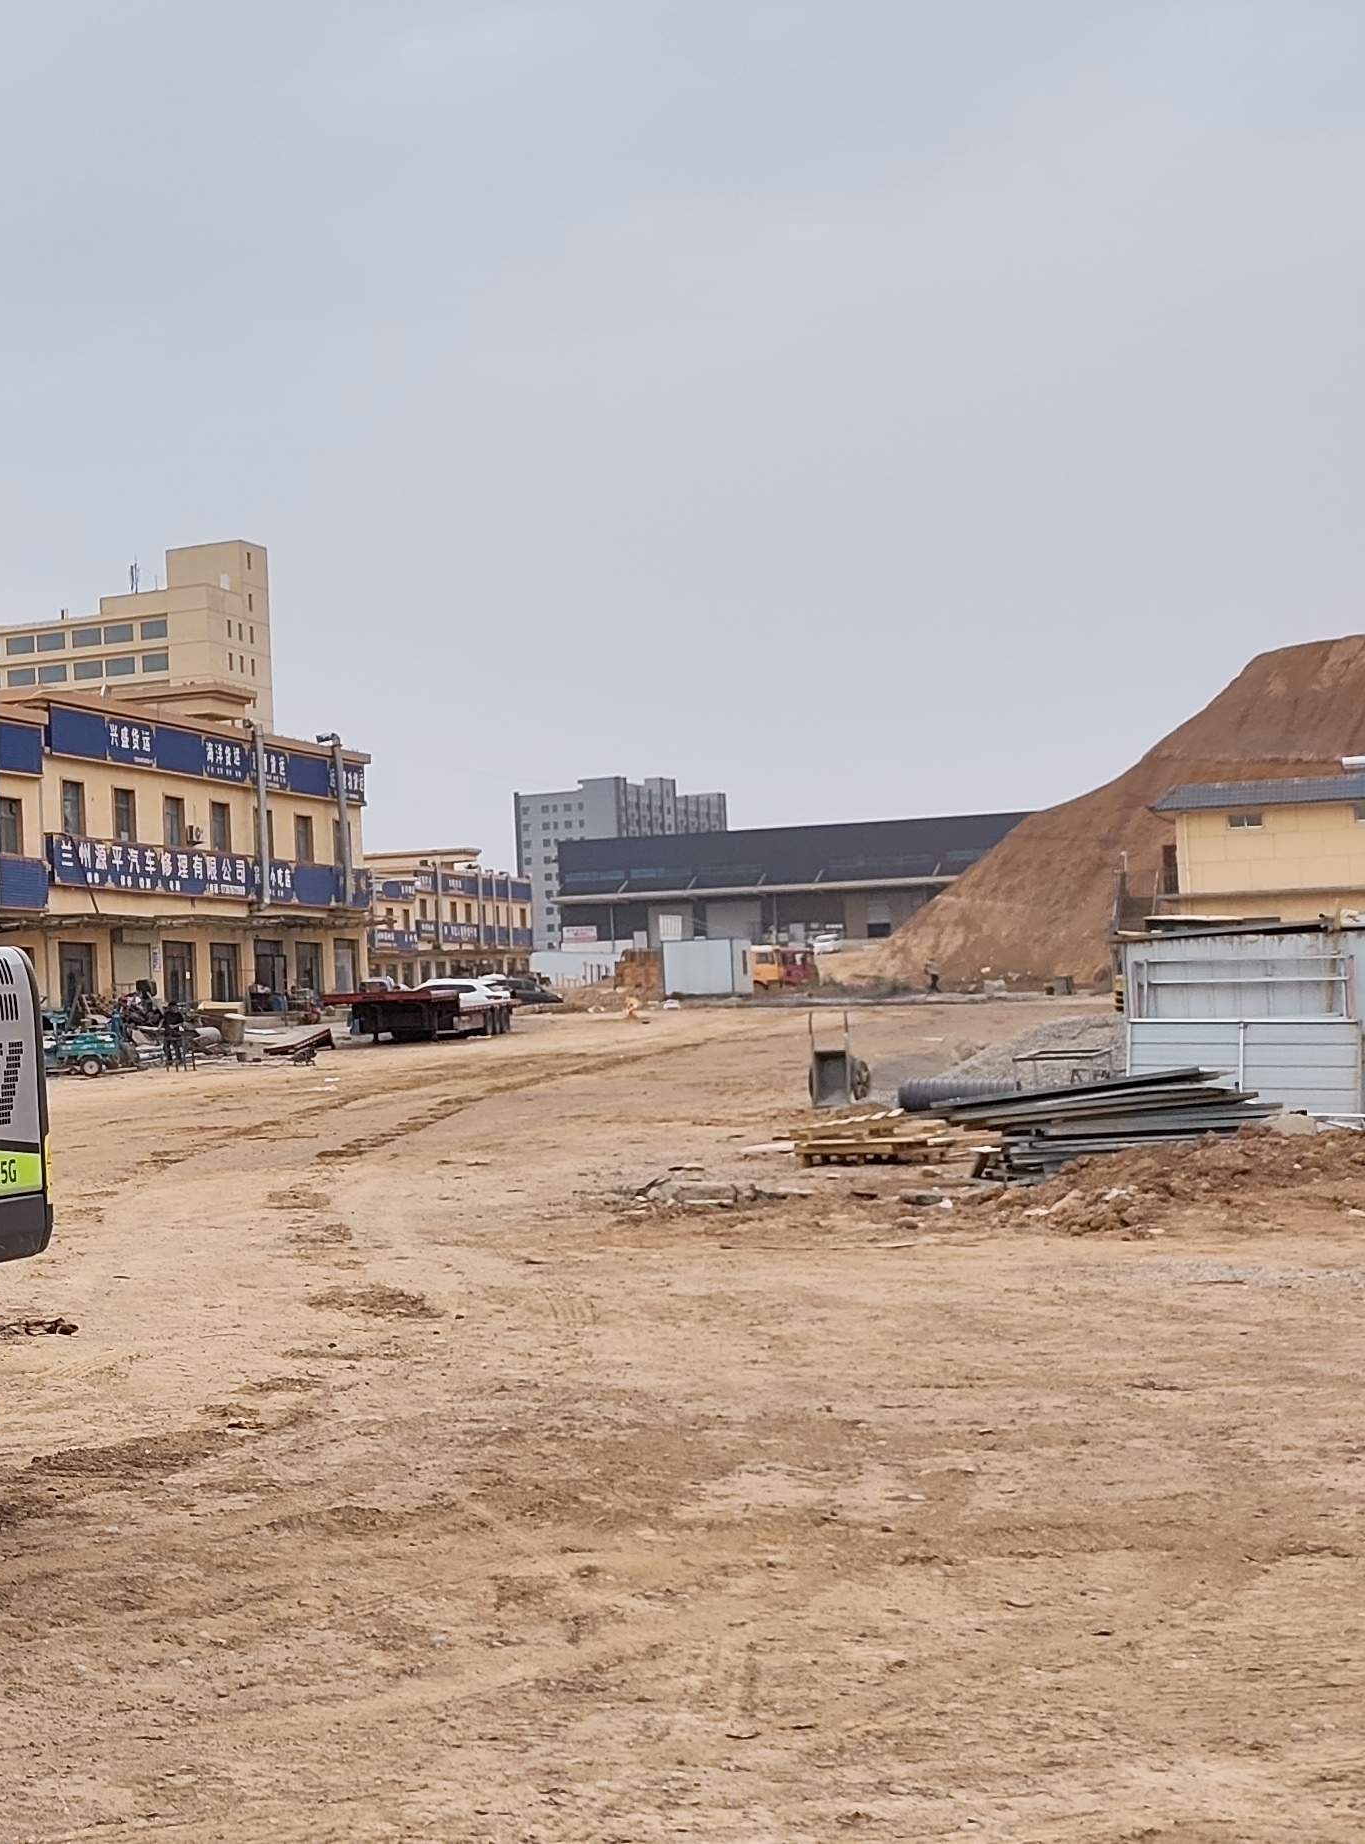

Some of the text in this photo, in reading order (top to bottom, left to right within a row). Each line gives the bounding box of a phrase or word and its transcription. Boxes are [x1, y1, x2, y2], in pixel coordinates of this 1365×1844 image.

[61, 839, 246, 884] 兰州源平汽车修理有限公司
